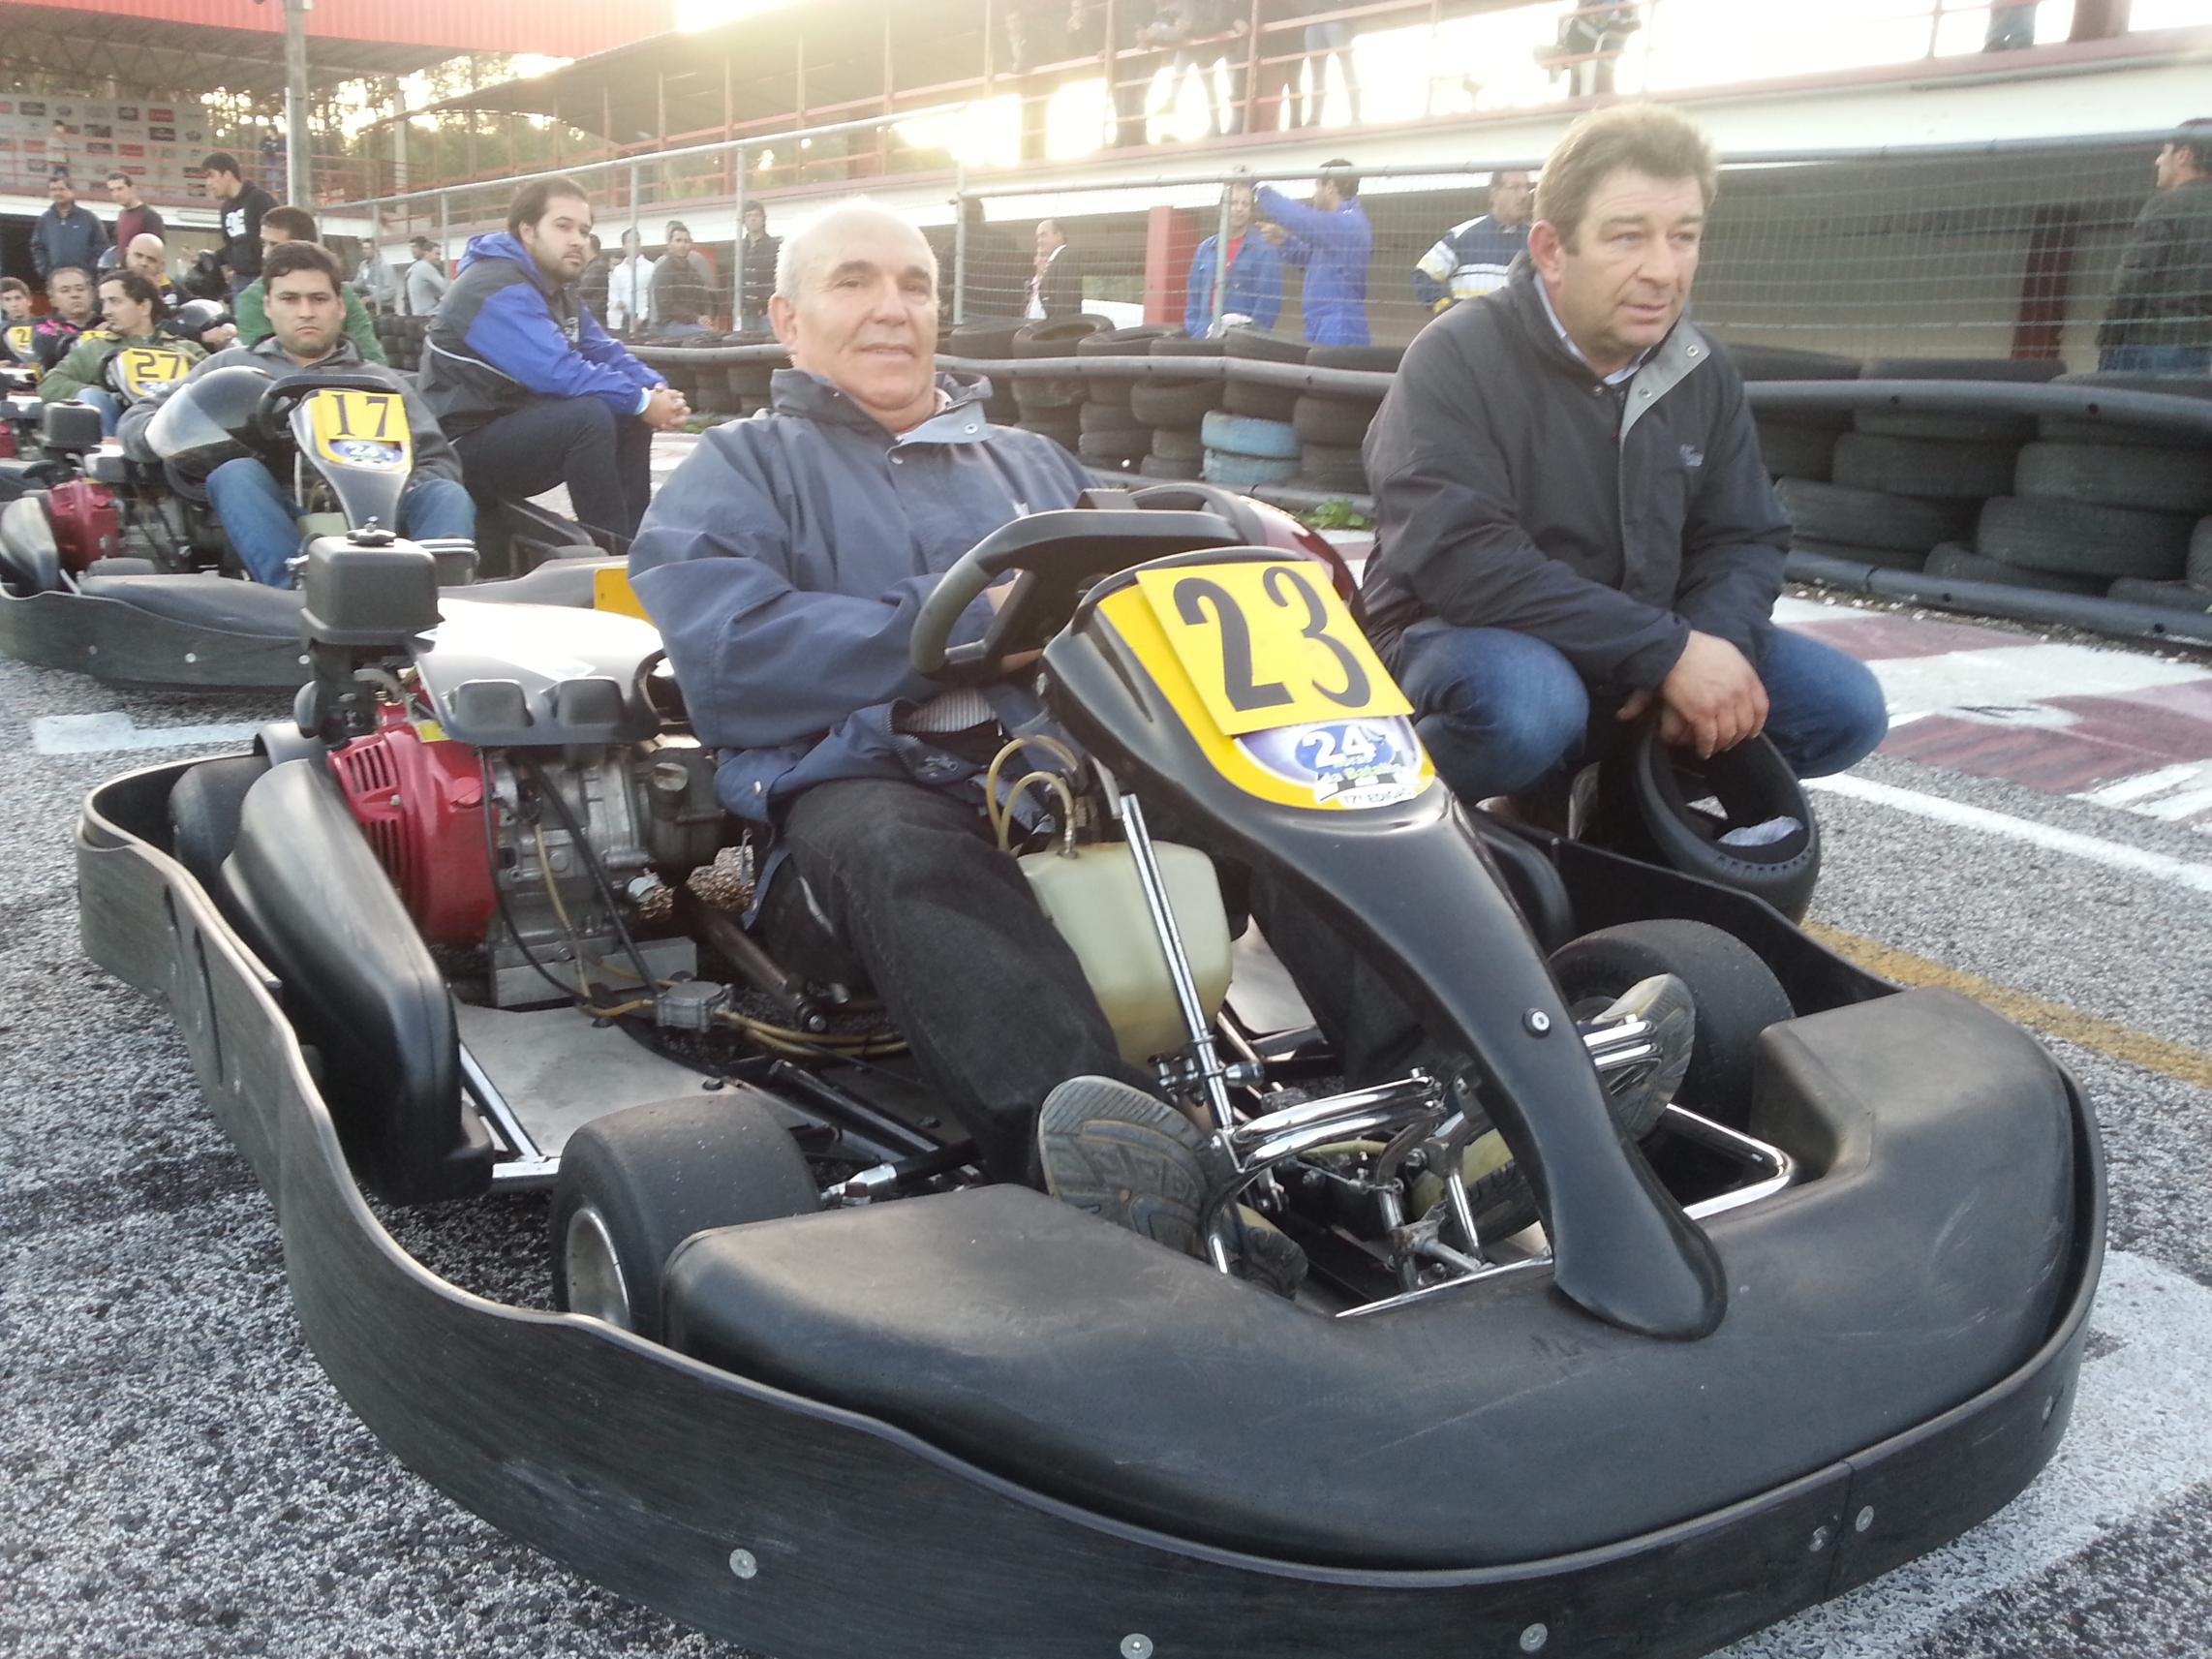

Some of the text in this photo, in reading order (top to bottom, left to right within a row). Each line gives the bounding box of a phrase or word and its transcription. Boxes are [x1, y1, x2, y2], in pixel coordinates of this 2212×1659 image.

[132, 350, 180, 380] 27
[330, 394, 388, 437] 17
[1173, 566, 1371, 712] 23
[1303, 725, 1376, 768] 24
